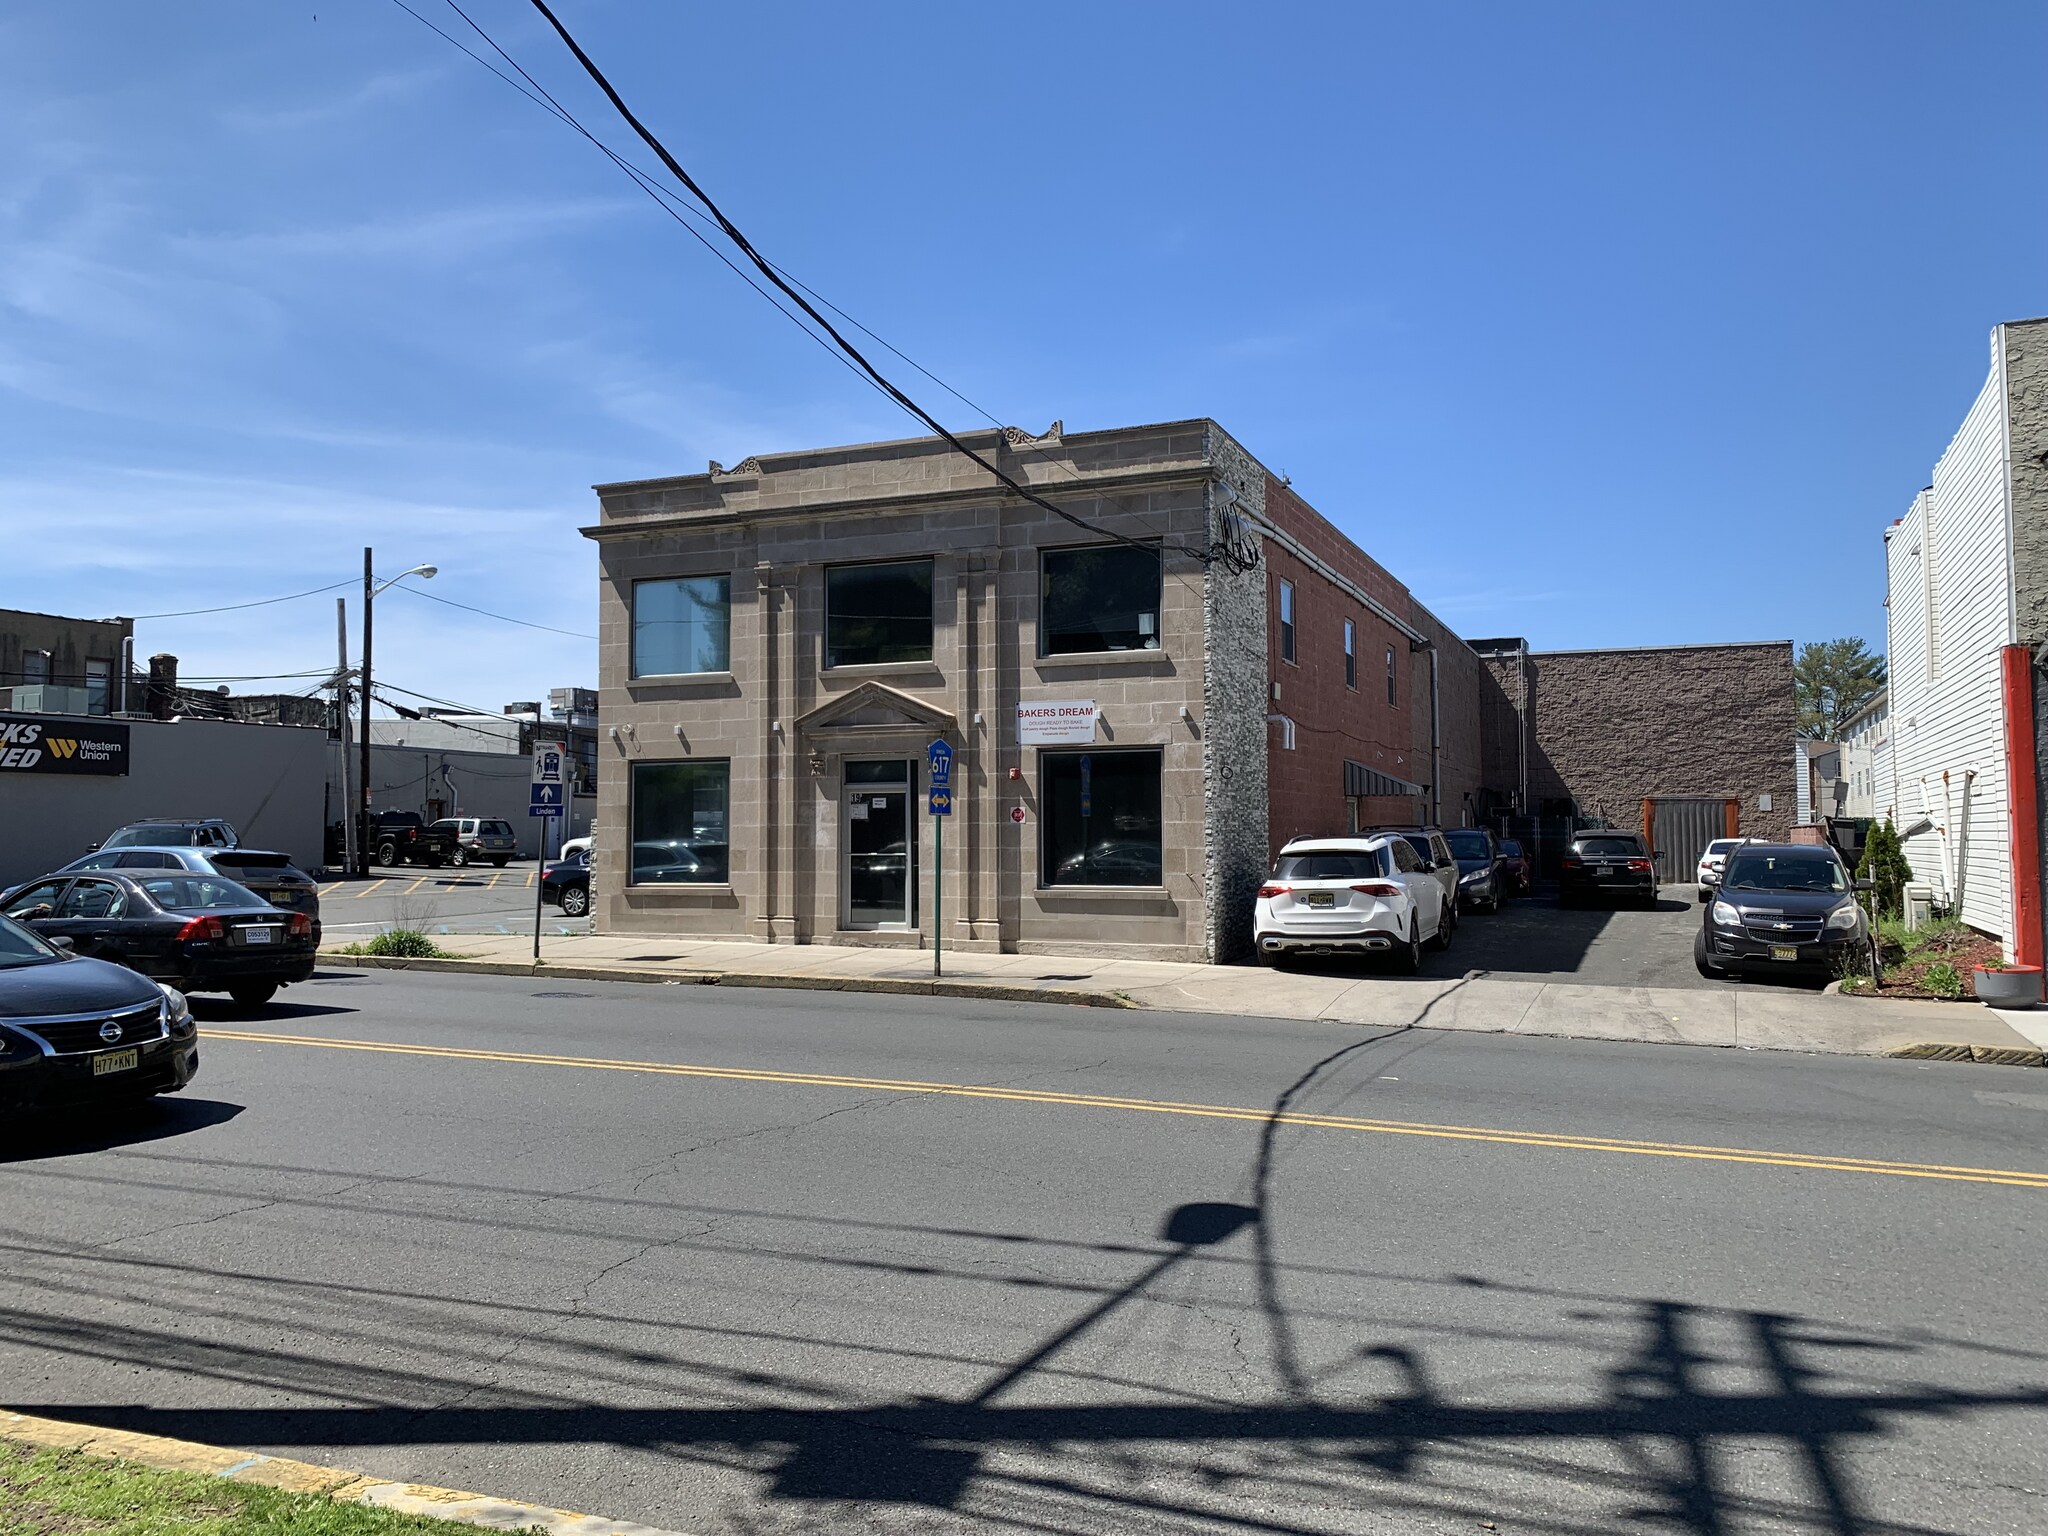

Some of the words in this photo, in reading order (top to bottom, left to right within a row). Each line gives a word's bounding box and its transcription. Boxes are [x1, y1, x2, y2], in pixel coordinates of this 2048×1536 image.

[1018, 709, 1056, 718] BAKERS
[1059, 707, 1093, 716] DREAM
[80, 740, 121, 752] Western
[80, 750, 110, 760] Union
[932, 756, 950, 773] 617
